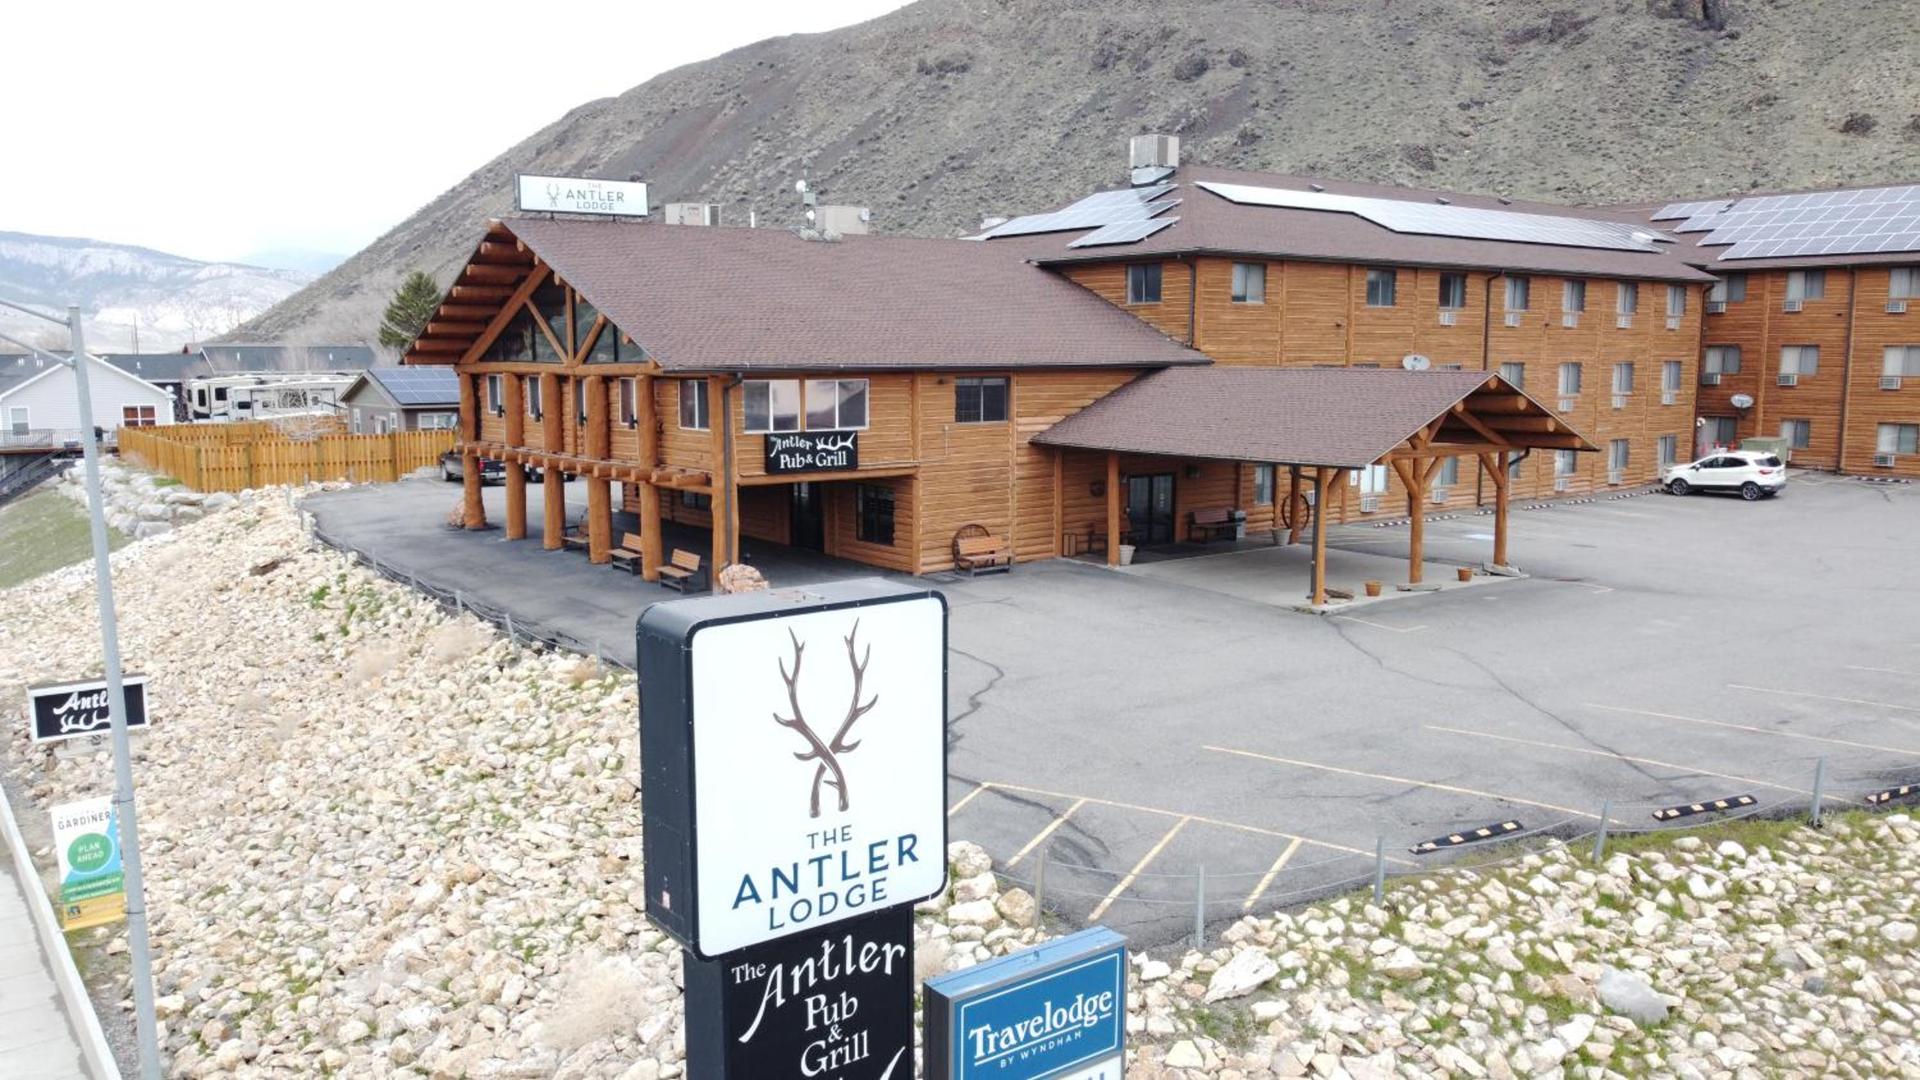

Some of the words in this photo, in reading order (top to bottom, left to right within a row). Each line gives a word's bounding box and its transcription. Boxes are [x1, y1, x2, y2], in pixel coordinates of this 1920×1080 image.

[566, 189, 625, 202] ANTLER
[576, 200, 615, 211] LODGE
[770, 435, 813, 457] Antler
[780, 453, 805, 469] Pub
[805, 454, 813, 464] &
[815, 450, 847, 467] Grill
[53, 690, 110, 715] Antl
[58, 811, 111, 830] GARDINER
[78, 841, 100, 853] PLAN
[806, 824, 853, 850] THE
[77, 850, 105, 863] AHEAD
[732, 833, 919, 910] ANTLER
[769, 877, 887, 930] LODGE
[731, 962, 766, 984] The
[738, 935, 906, 1043] Antler
[804, 991, 858, 1031] Pub
[828, 1024, 843, 1043] &
[968, 990, 1113, 1060] Travelodge
[801, 1029, 870, 1077] Grill
[1000, 1054, 1014, 1069] BY
[1020, 1030, 1083, 1060] WYNDHAM
